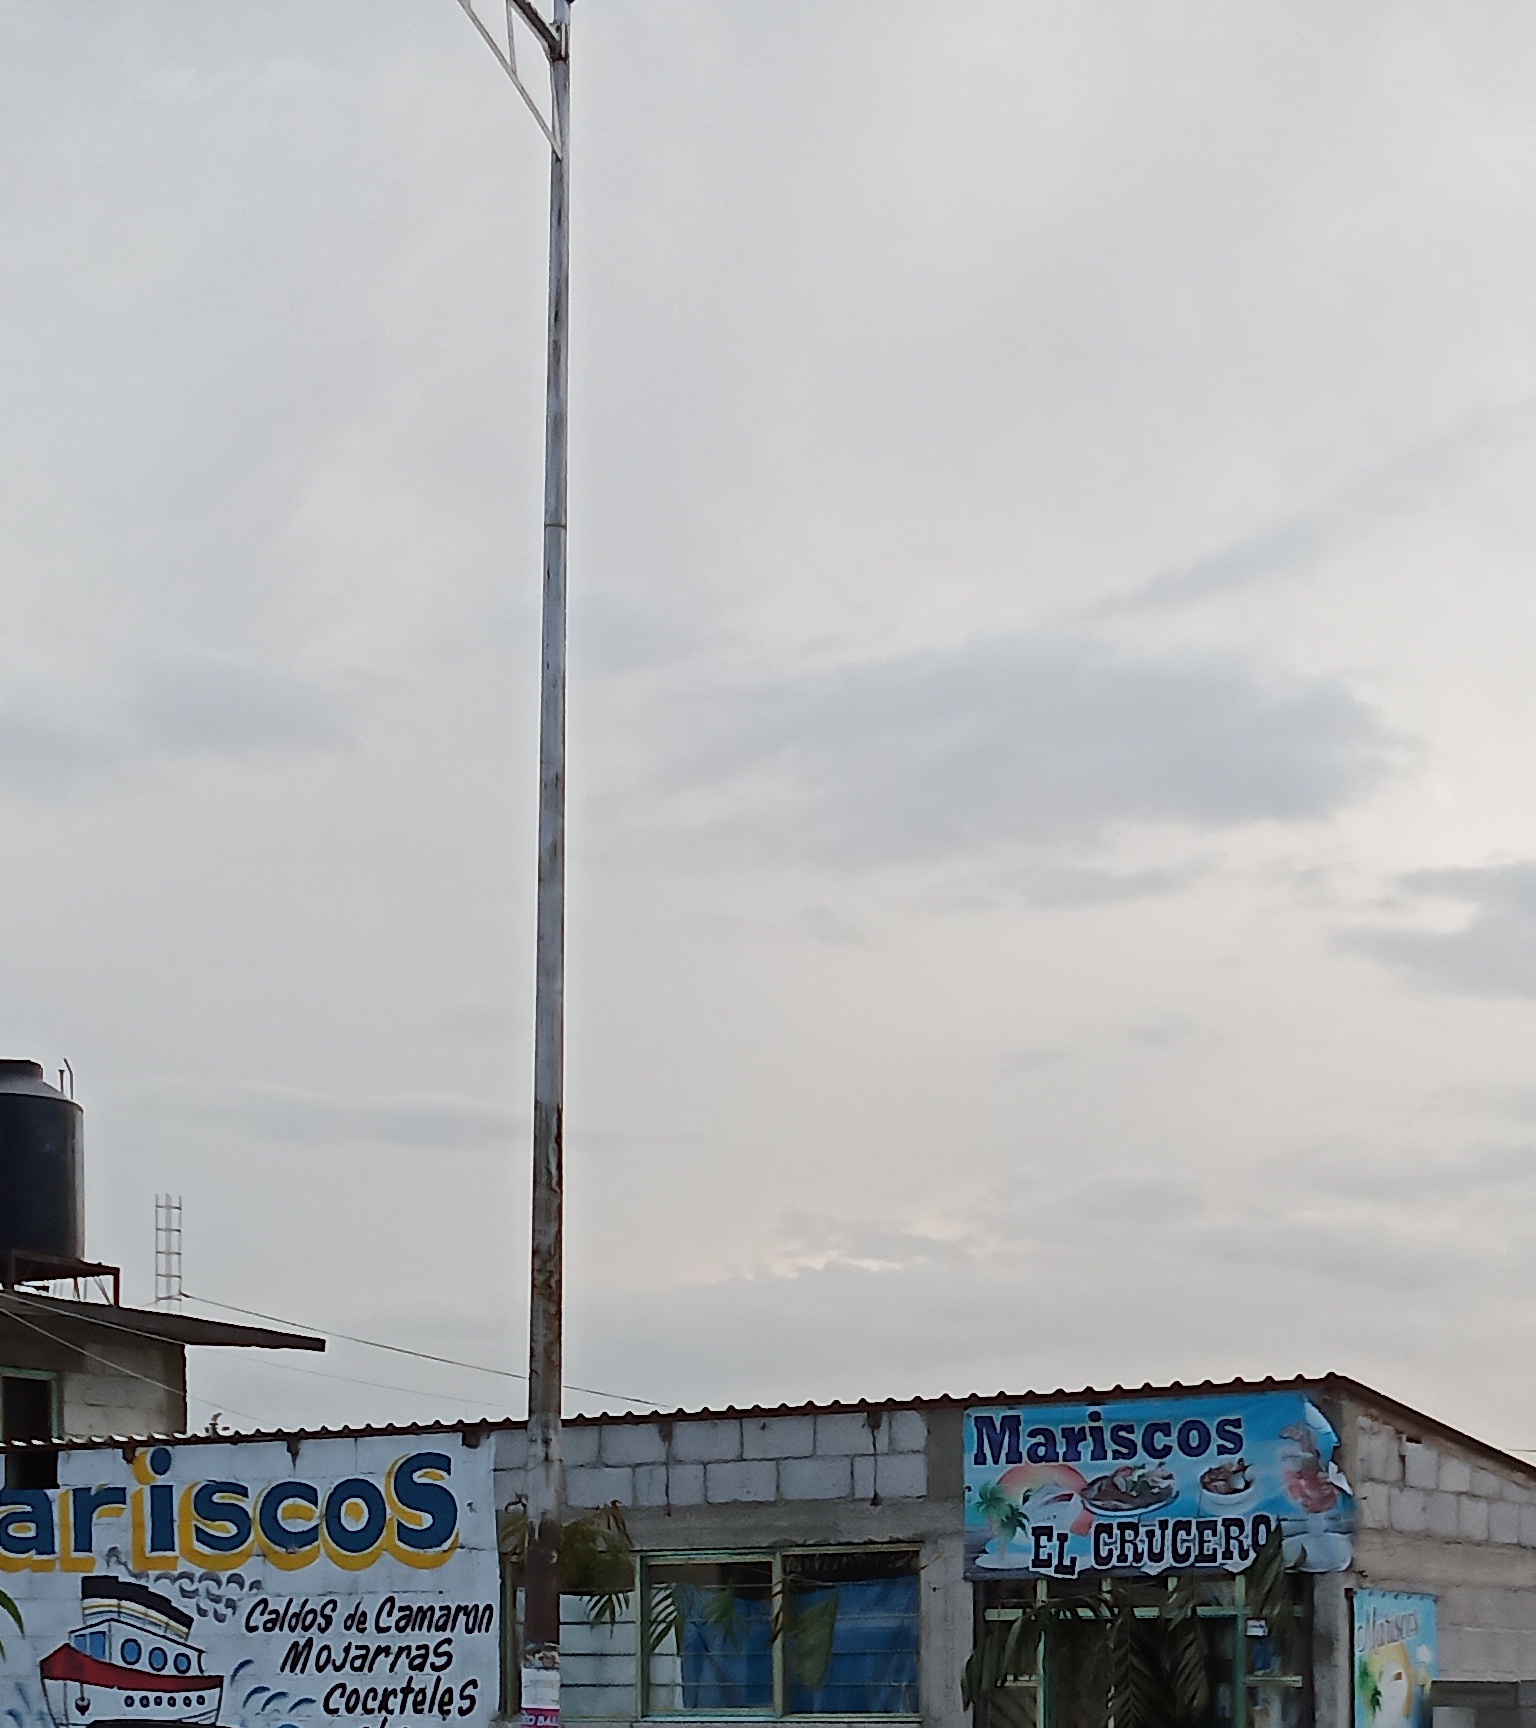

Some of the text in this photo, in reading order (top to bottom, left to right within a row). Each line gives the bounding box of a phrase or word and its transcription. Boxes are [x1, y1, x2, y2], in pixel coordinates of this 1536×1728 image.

[973, 1409, 1245, 1466] Mariscos
[1029, 1512, 1273, 1577] EL CRUCERO
[343, 1600, 368, 1633] de
[373, 1595, 495, 1635] Camaron
